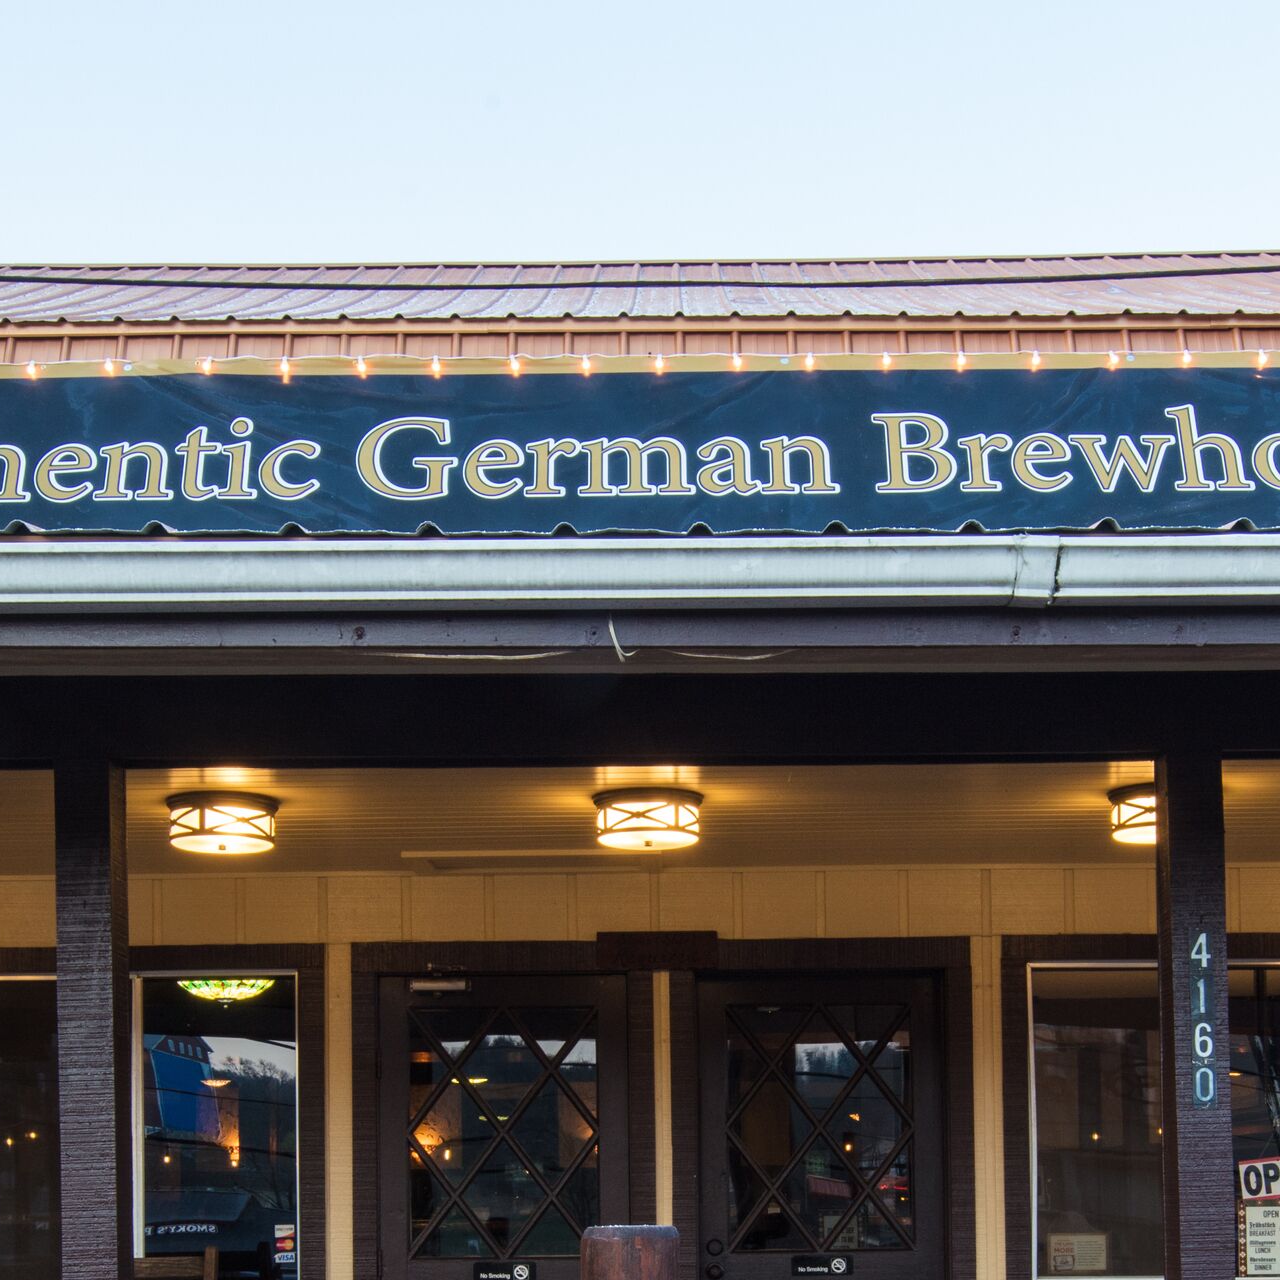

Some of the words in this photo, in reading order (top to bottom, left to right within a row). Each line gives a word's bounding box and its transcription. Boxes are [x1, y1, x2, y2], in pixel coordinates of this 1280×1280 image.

[355, 416, 841, 501] German
[1190, 932, 1215, 1102] 4160
[1263, 1210, 1279, 1218] OPEN
